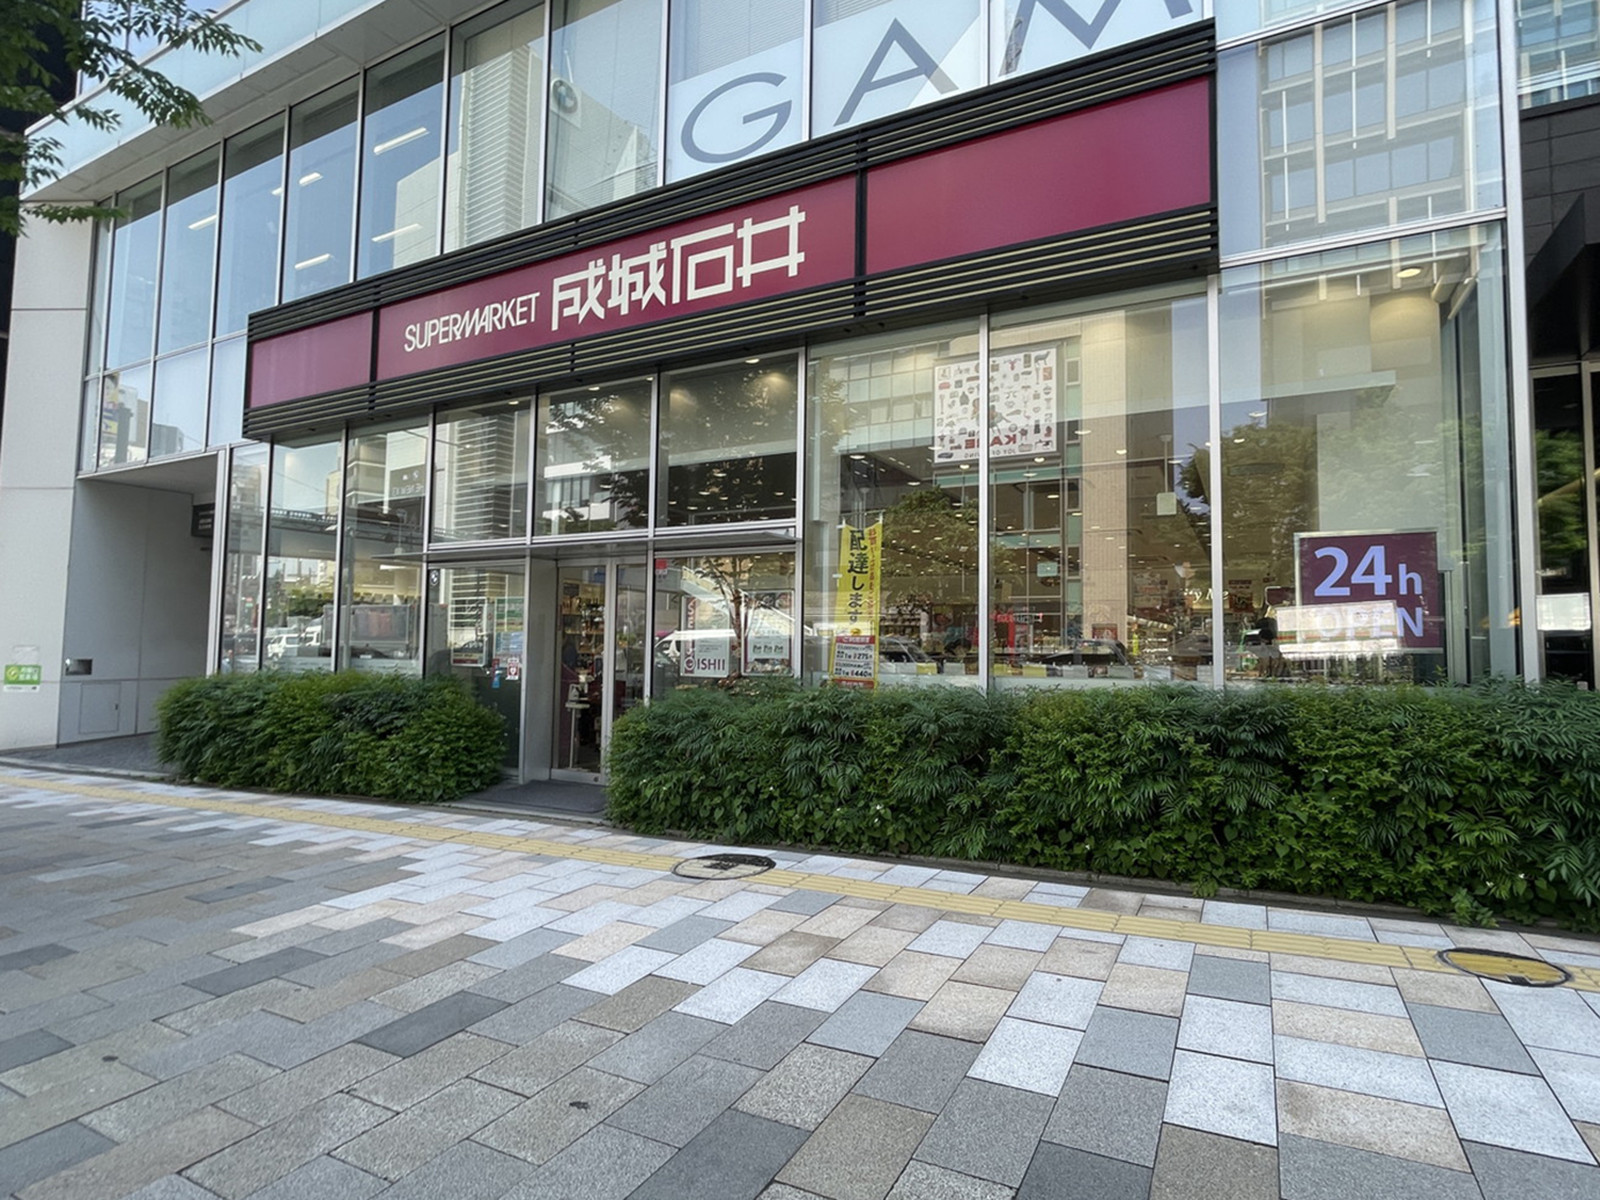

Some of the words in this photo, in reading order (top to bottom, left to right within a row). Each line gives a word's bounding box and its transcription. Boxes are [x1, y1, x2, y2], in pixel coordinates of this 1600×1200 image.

[403, 291, 541, 353] SUPERMARKET
[551, 204, 806, 331] 成城石井
[847, 530, 869, 623] 配達します
[1313, 545, 1423, 597] 24h
[1315, 606, 1424, 638] OPEN
